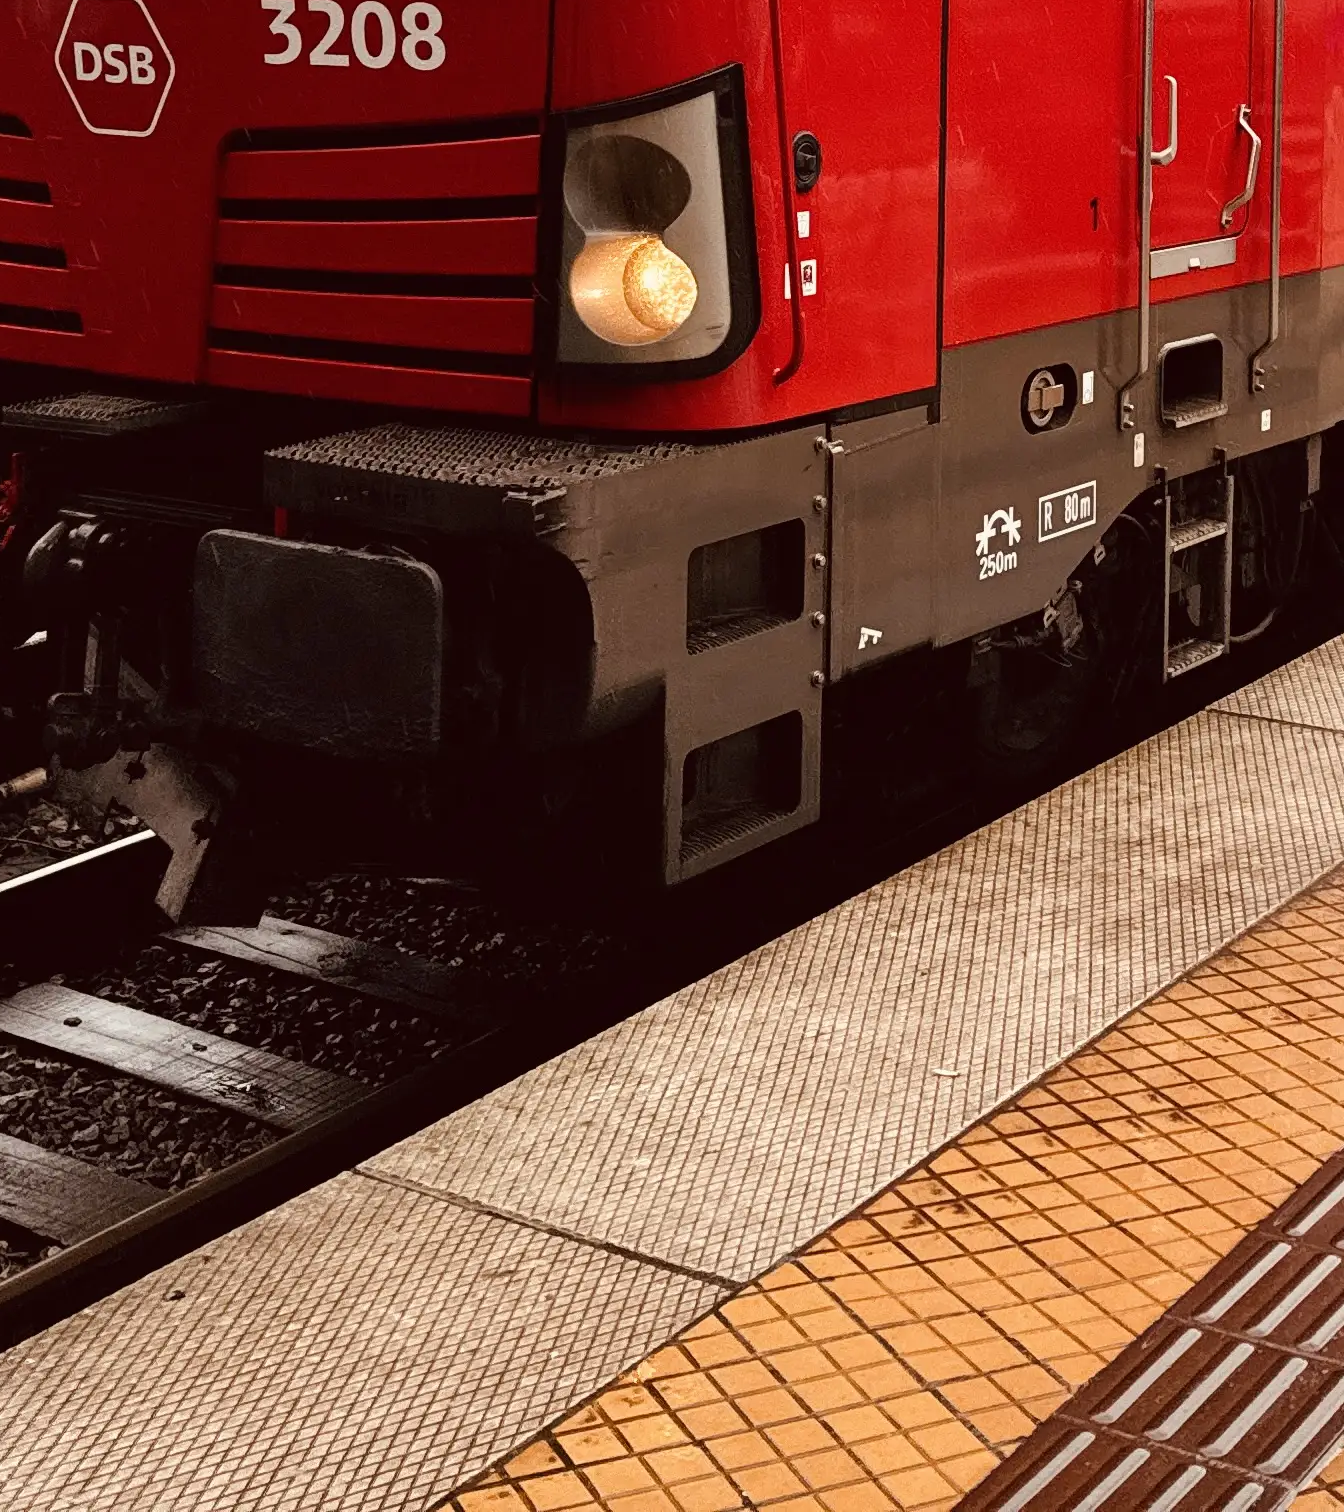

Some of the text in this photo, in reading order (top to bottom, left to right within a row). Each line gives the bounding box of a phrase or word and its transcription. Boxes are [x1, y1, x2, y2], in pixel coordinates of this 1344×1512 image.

[73, 42, 156, 85] DSB
[1090, 196, 1098, 232] 1
[1044, 502, 1053, 532] R
[978, 551, 1018, 581] 250m
